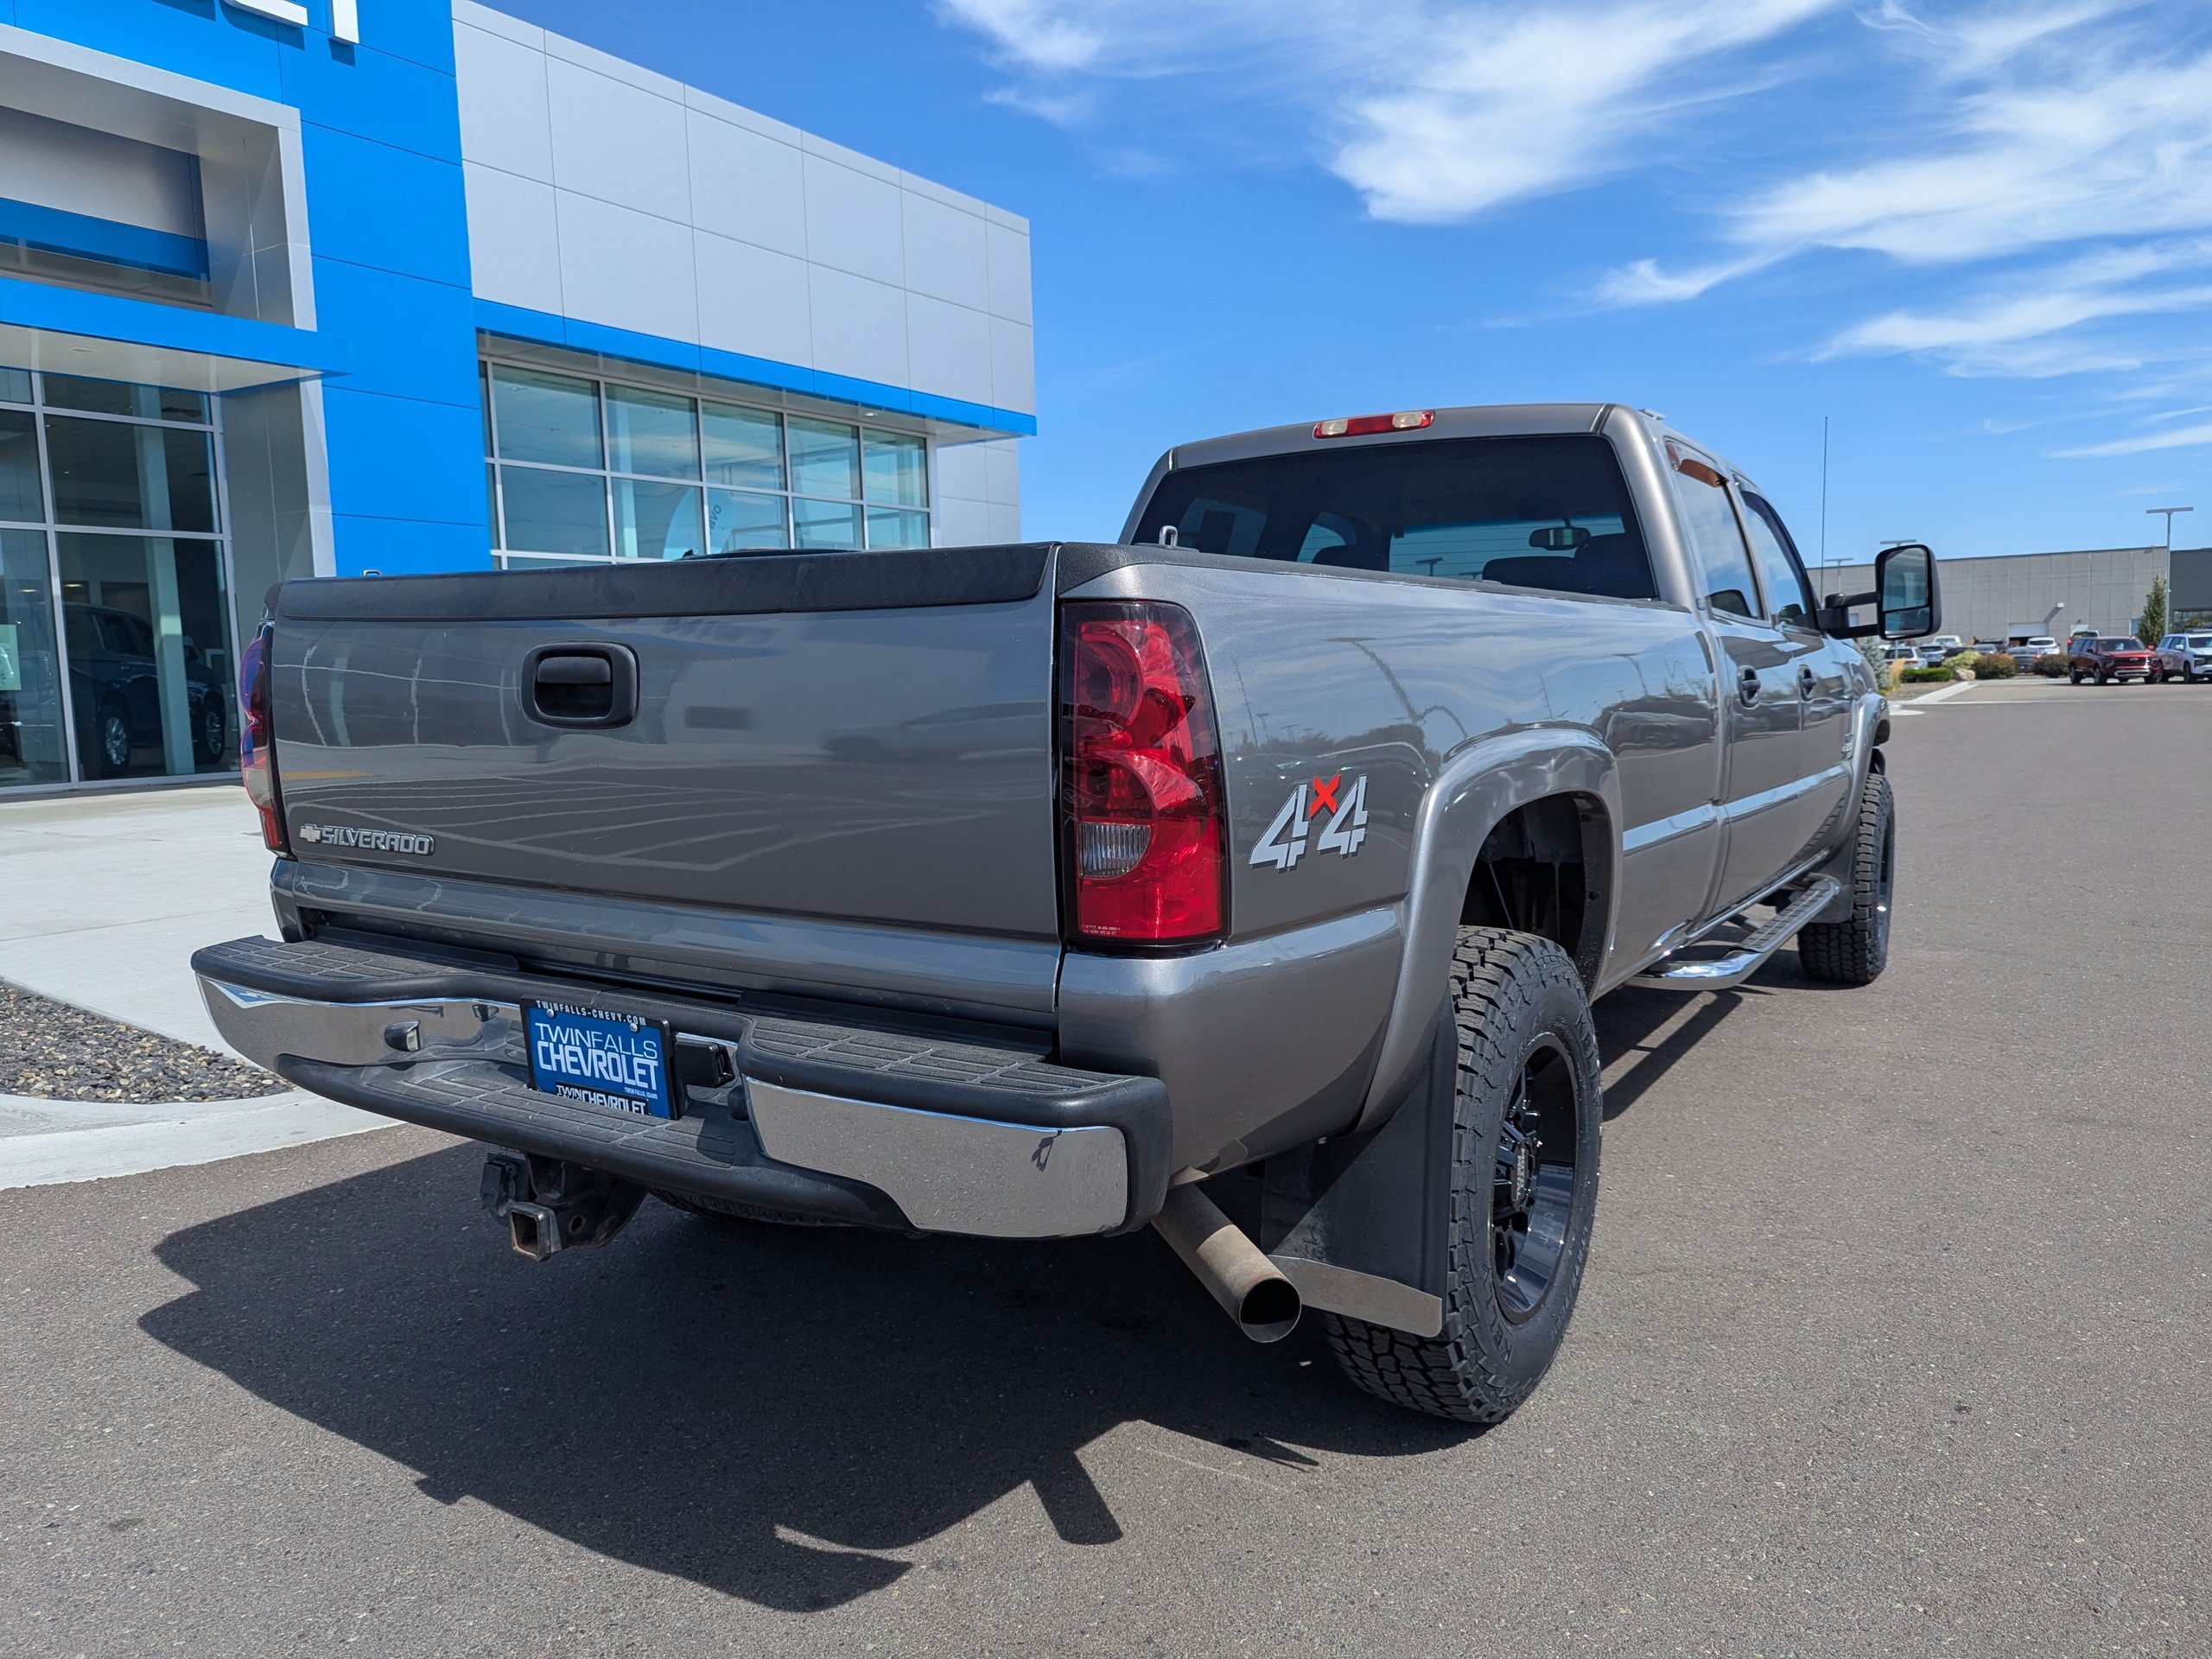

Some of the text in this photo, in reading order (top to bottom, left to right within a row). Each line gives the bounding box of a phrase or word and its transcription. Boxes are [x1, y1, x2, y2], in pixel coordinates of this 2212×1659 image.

[321, 826, 431, 855] SILVERADO
[536, 1000, 646, 1027] TWINFALLS-CHEVY.COM
[537, 1040, 658, 1090] CHEVROLET
[556, 1084, 582, 1098] TWIN
